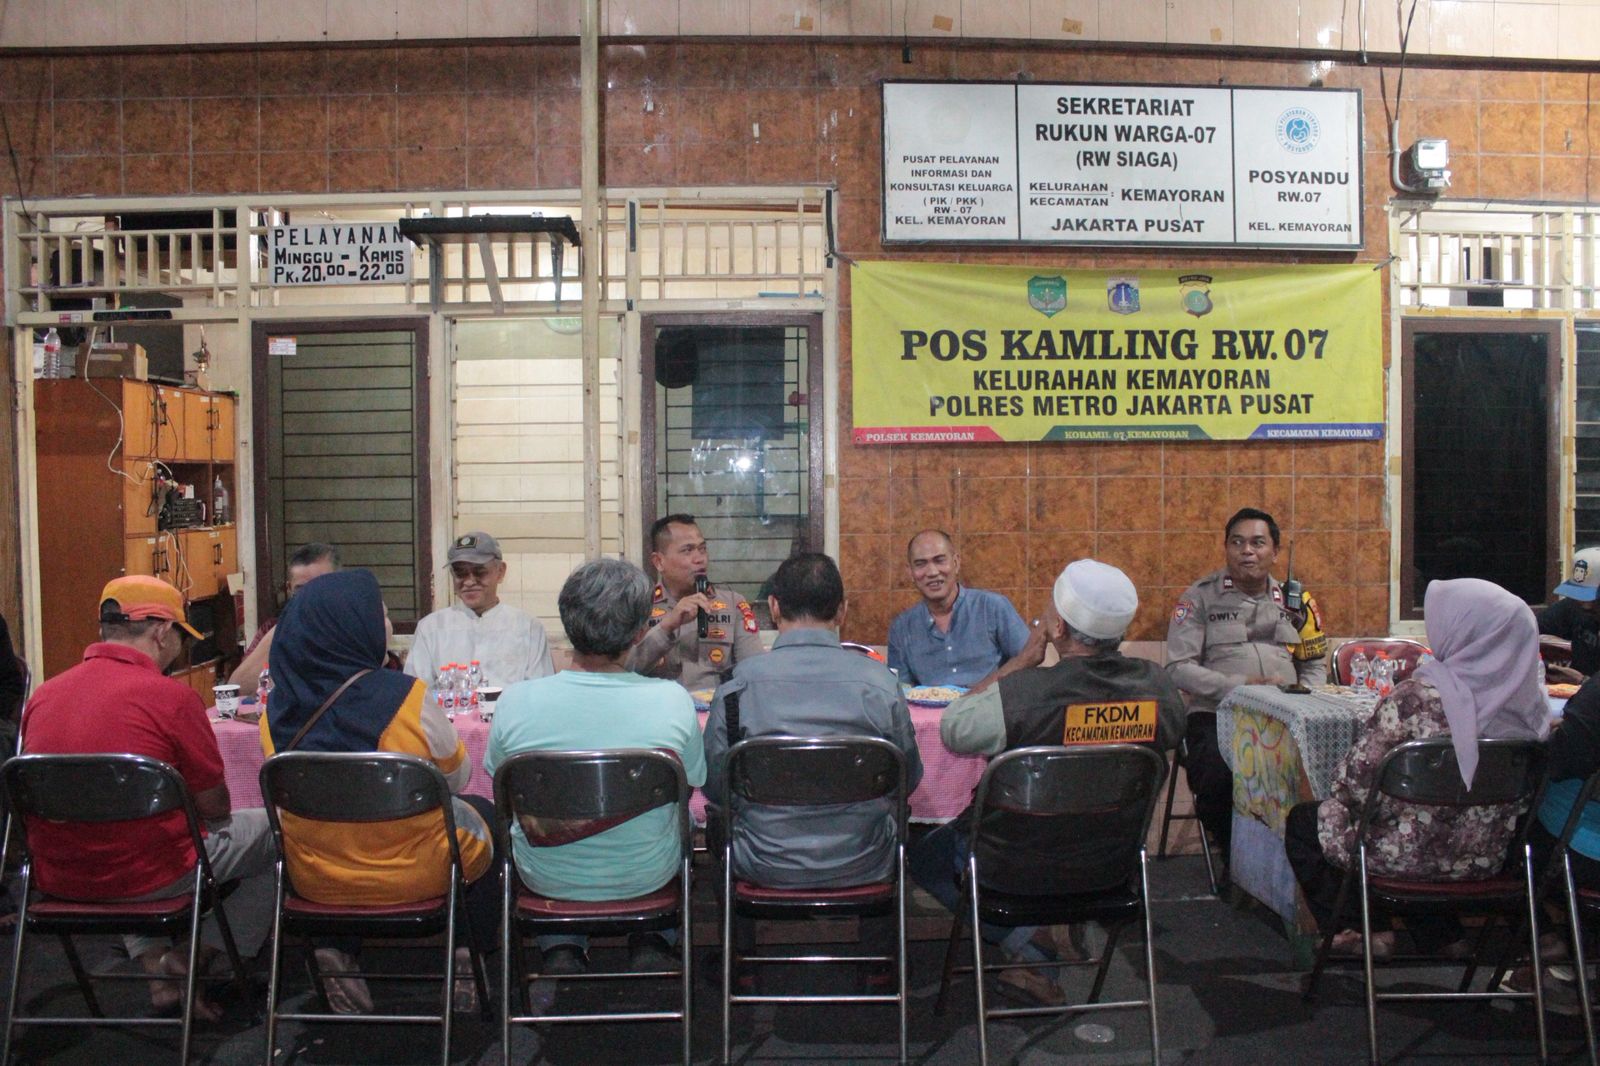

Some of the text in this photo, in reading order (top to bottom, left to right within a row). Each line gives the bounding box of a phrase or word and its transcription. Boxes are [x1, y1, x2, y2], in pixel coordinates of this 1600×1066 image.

[1056, 96, 1195, 117] SEKRETARIAT
[1035, 123, 1216, 144] RUKUN WARGA-07
[902, 155, 1000, 164] PUSAT PELAYANAN
[1076, 150, 1178, 172] (RW SIAGA)
[911, 169, 992, 178] INFORMASI DAN
[1248, 169, 1349, 185] POSYANDU
[890, 182, 1013, 192] KONSULTASI KELUARGA
[1029, 182, 1109, 192] KELURAHAN
[930, 197, 948, 205] PIK
[956, 197, 977, 205] PKK
[1121, 188, 1225, 203] KEMAYORAN
[1277, 191, 1322, 203] RW.07
[1029, 197, 1109, 207] KECAMATAN
[934, 206, 951, 214] RW
[959, 206, 973, 214] 07
[895, 215, 1006, 225] KEL. KEMAYORAN
[1051, 218, 1205, 233] JAKARTA PUSAT
[1248, 221, 1352, 233] KEL. KEMAYORAN
[274, 226, 404, 246] PELAYANAN
[900, 329, 988, 362] POS
[1000, 328, 1199, 361] KAMLING
[973, 368, 1270, 391] KELURAHAN KEMAYORAN
[929, 393, 1314, 417] POLRES METRO JAKARTA PUSAT
[866, 432, 975, 441] POLSEK KEMAYORAN
[1064, 431, 1111, 439] KORAMIL
[1127, 430, 1189, 439] KEMAYORAN
[1267, 429, 1373, 438] KECAMATAN KEMAYORAN
[707, 614, 731, 624] OLRI
[1084, 705, 1140, 724] FKDM
[1066, 723, 1154, 742] KECAMATAN KEMAYORAN
